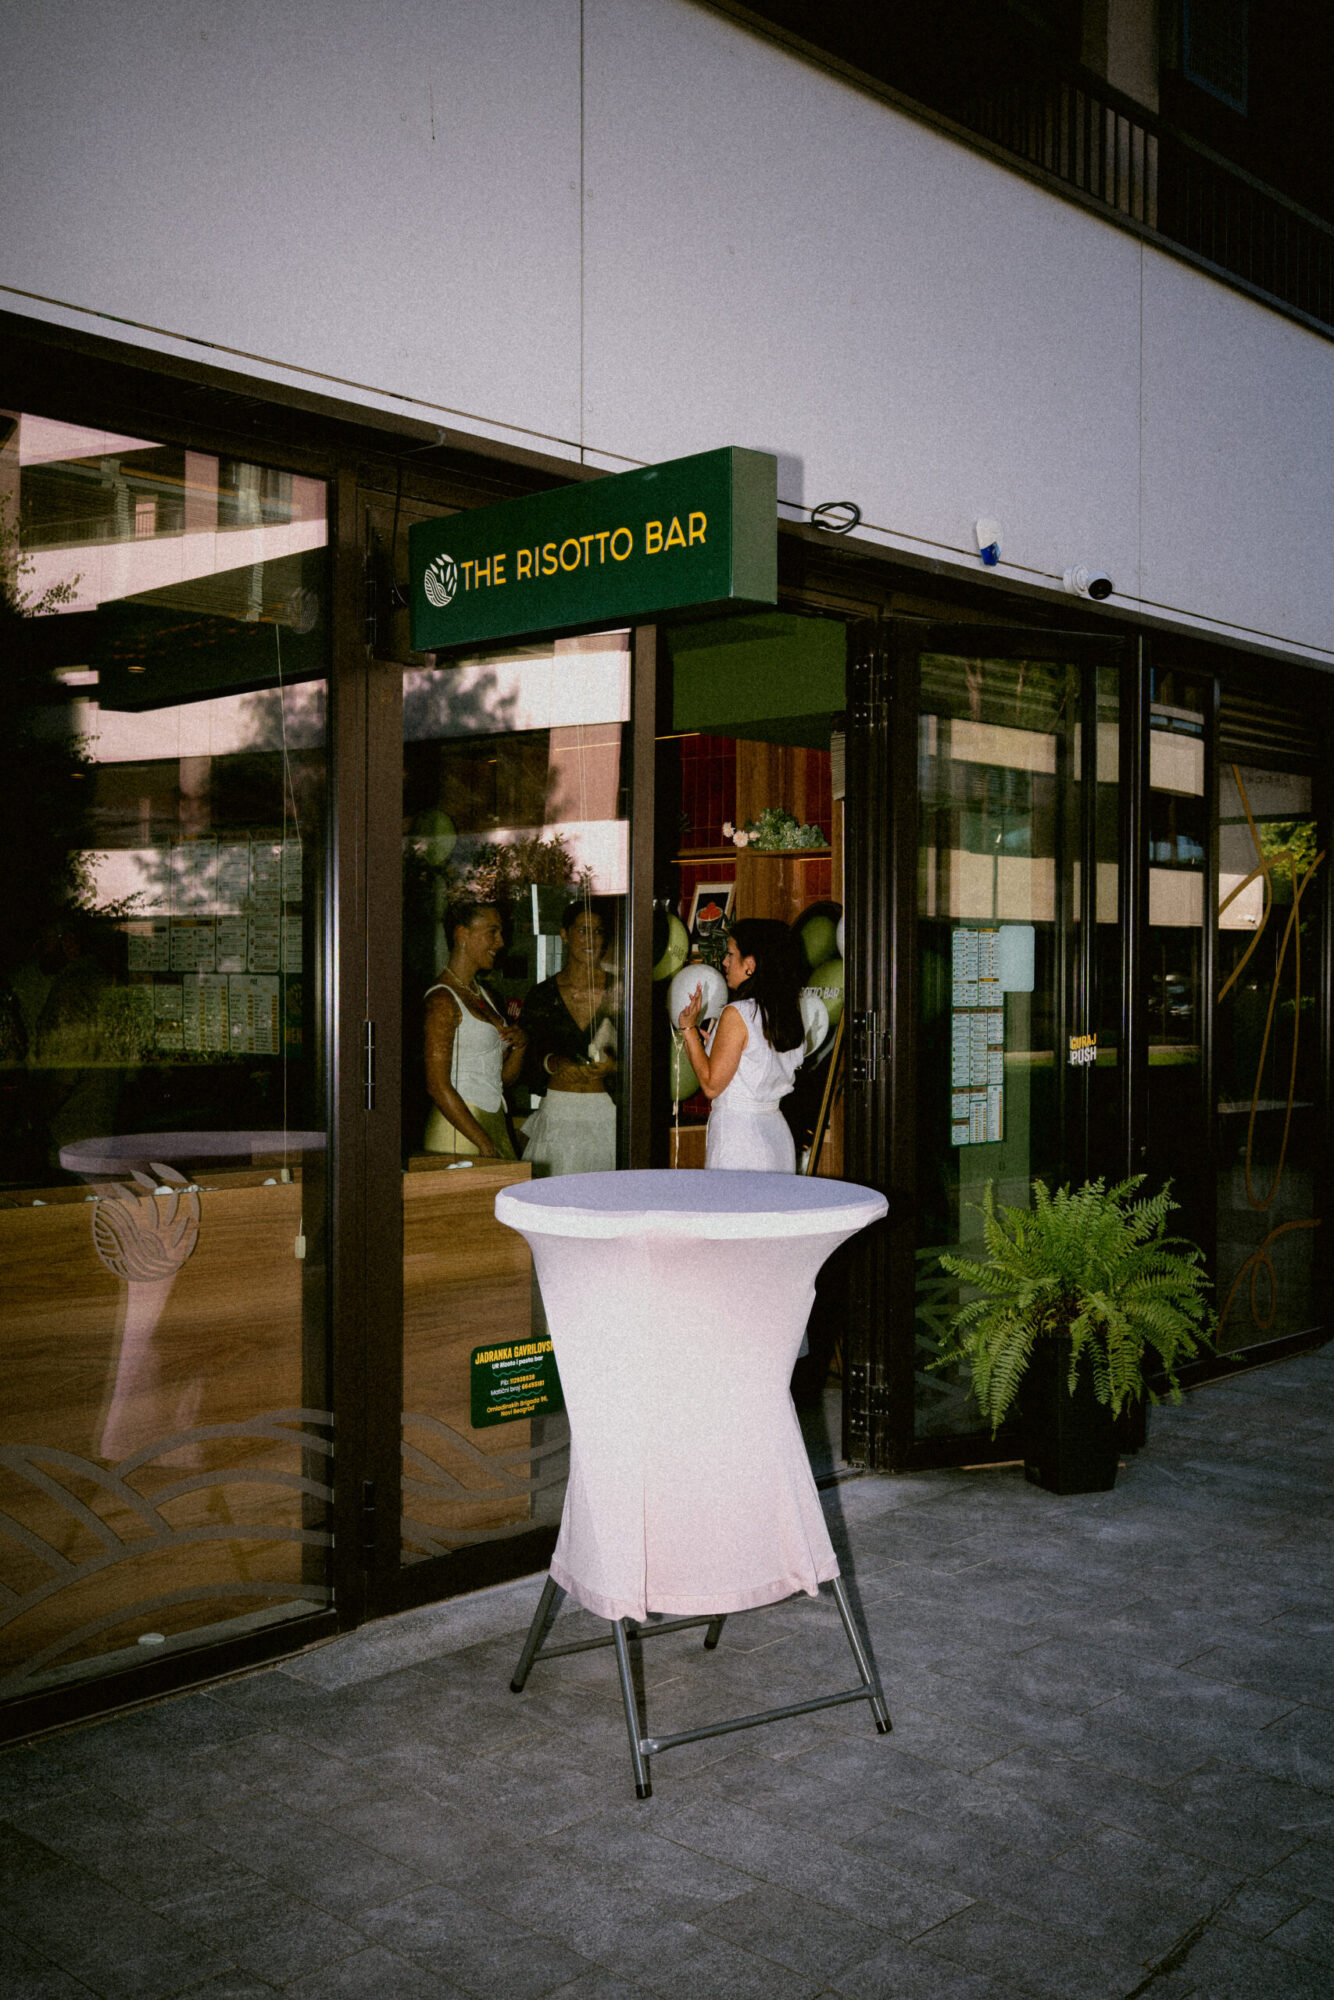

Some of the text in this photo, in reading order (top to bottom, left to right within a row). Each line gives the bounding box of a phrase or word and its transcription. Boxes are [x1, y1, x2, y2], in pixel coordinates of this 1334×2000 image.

[461, 511, 708, 591] THE RISOTTO BAR
[823, 987, 840, 999] BAR
[1070, 1033, 1097, 1050] GURAJ
[1071, 1046, 1097, 1065] PUSH
[475, 1347, 512, 1365] JADRANKA
[519, 1357, 533, 1366] pasta
[501, 1404, 535, 1417] Novi Beograd
